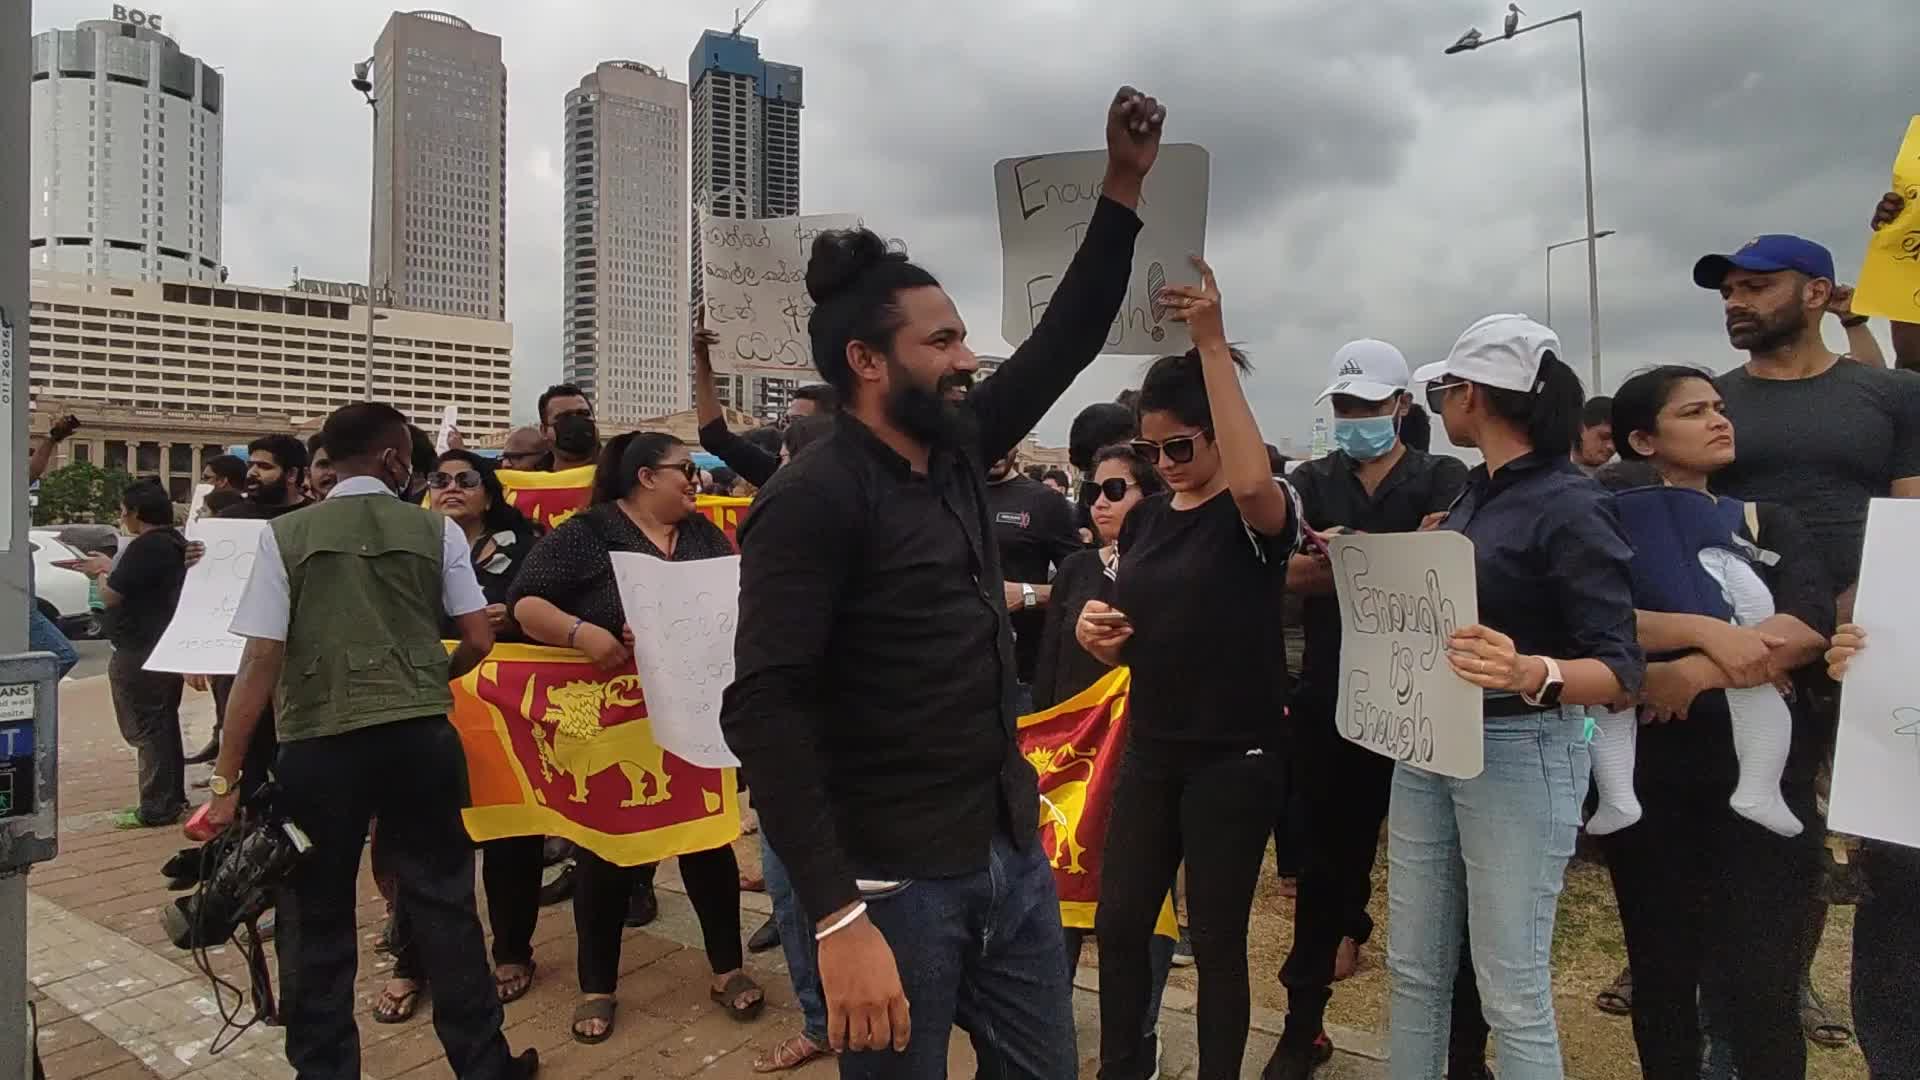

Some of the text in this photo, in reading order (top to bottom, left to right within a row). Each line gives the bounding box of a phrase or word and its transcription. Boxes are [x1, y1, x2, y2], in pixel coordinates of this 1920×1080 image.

[112, 4, 162, 31] BOC
[1341, 546, 1456, 671] Enough
[1389, 640, 1414, 705] is
[1346, 669, 1434, 763] Enough
